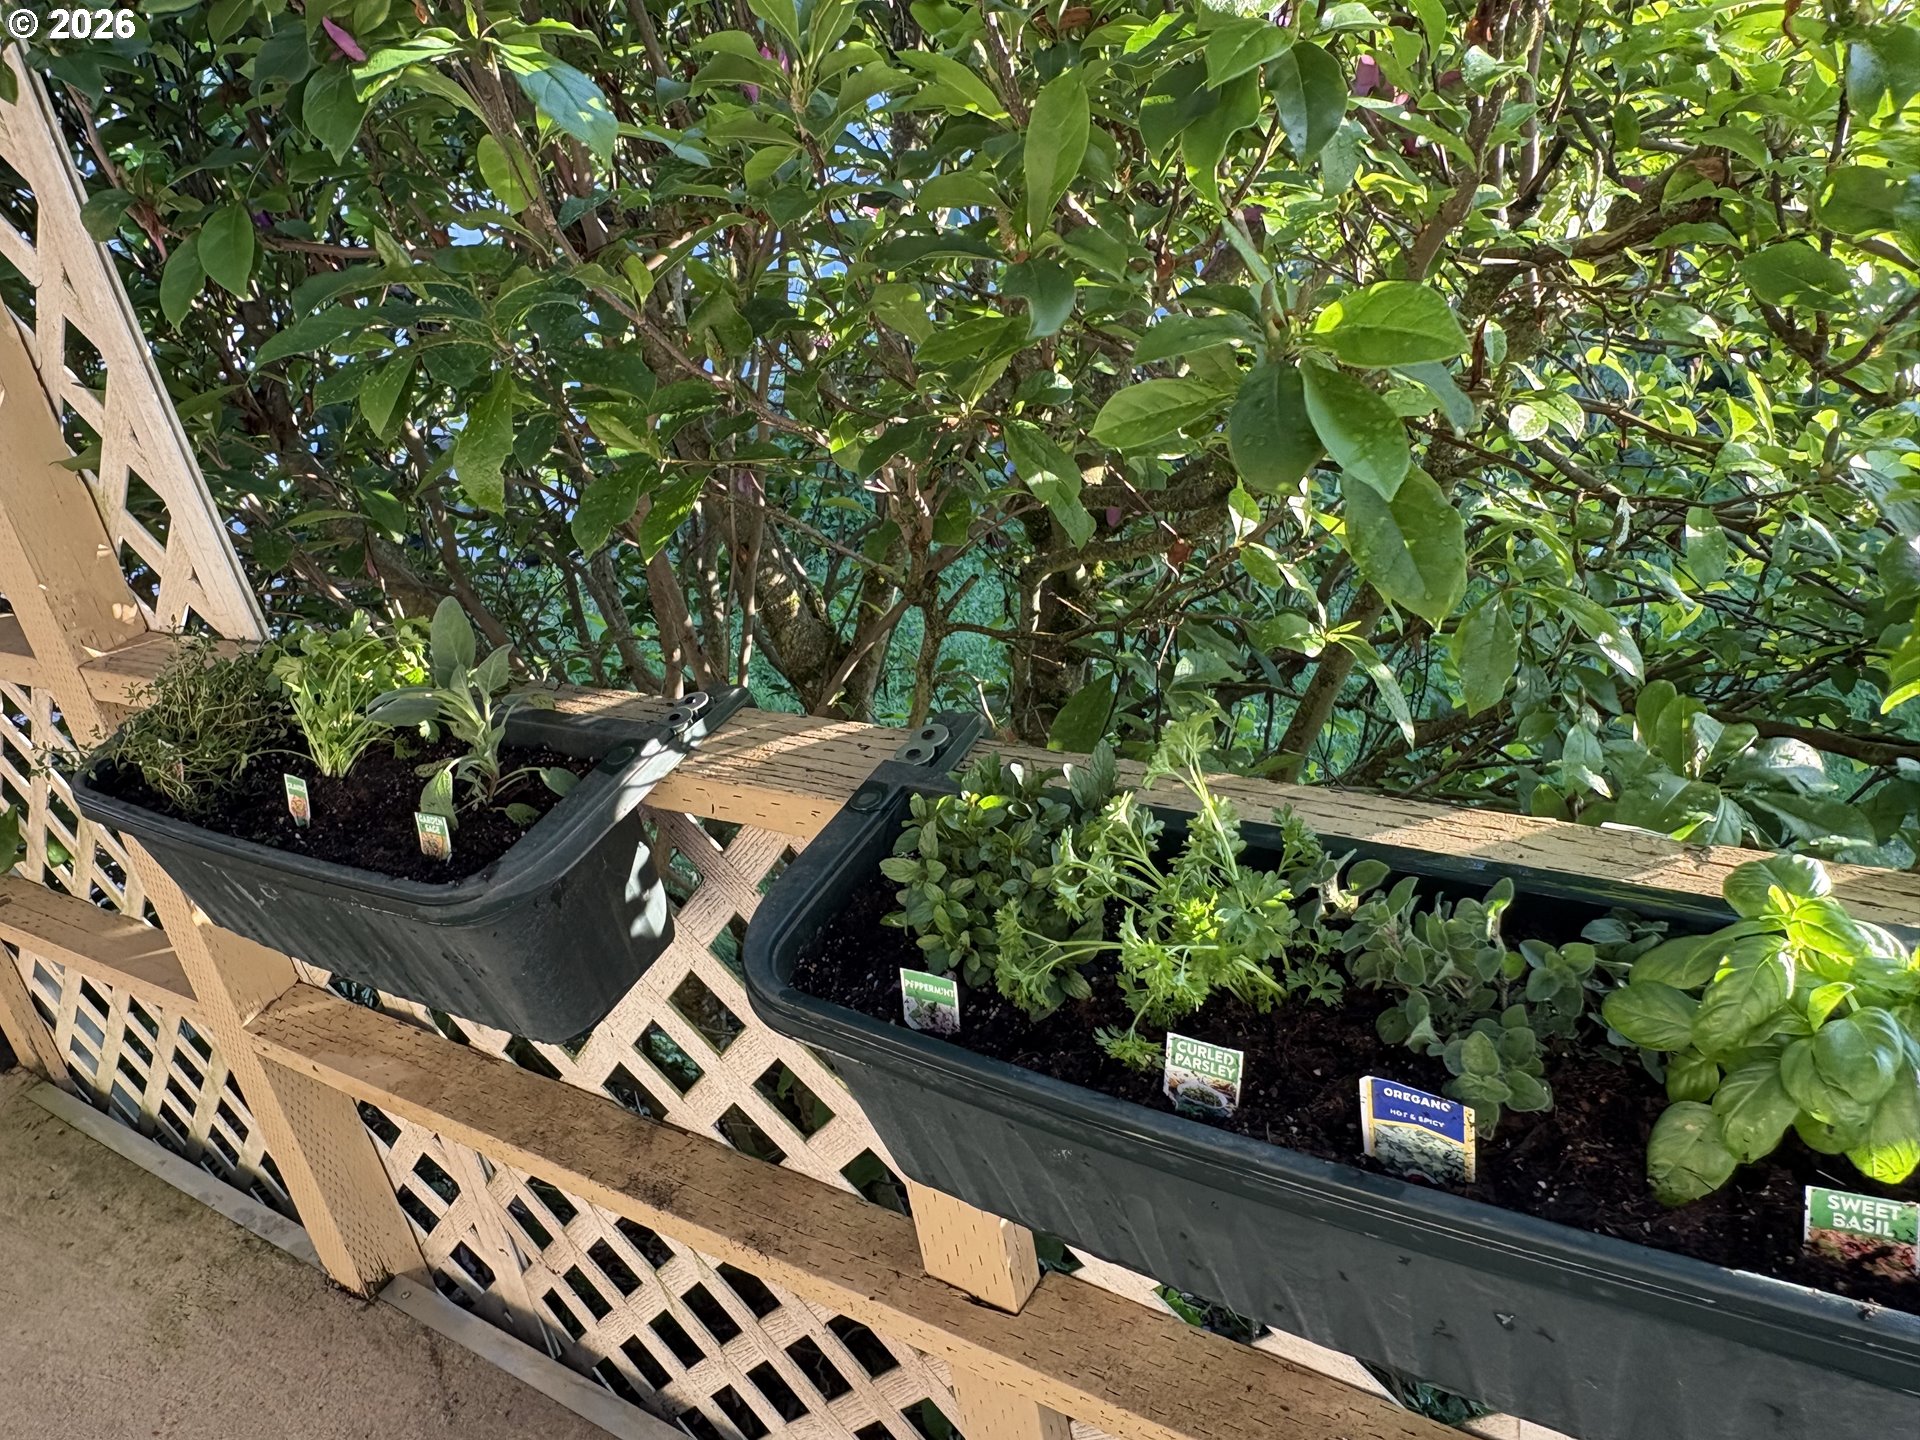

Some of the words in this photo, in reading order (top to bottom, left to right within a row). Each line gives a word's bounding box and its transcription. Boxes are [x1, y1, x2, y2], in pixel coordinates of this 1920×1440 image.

[904, 978, 954, 998] PEPPERMINT
[1174, 1052, 1236, 1080] PARSLEY
[1176, 1040, 1234, 1066] CURLED
[1383, 1087, 1451, 1112] OREGANO
[1389, 1108, 1408, 1118] HOT
[1410, 1113, 1417, 1121] &
[1418, 1115, 1445, 1128] SPICY
[1827, 1194, 1902, 1221] SWEET
[1832, 1212, 1895, 1238] BASIL
